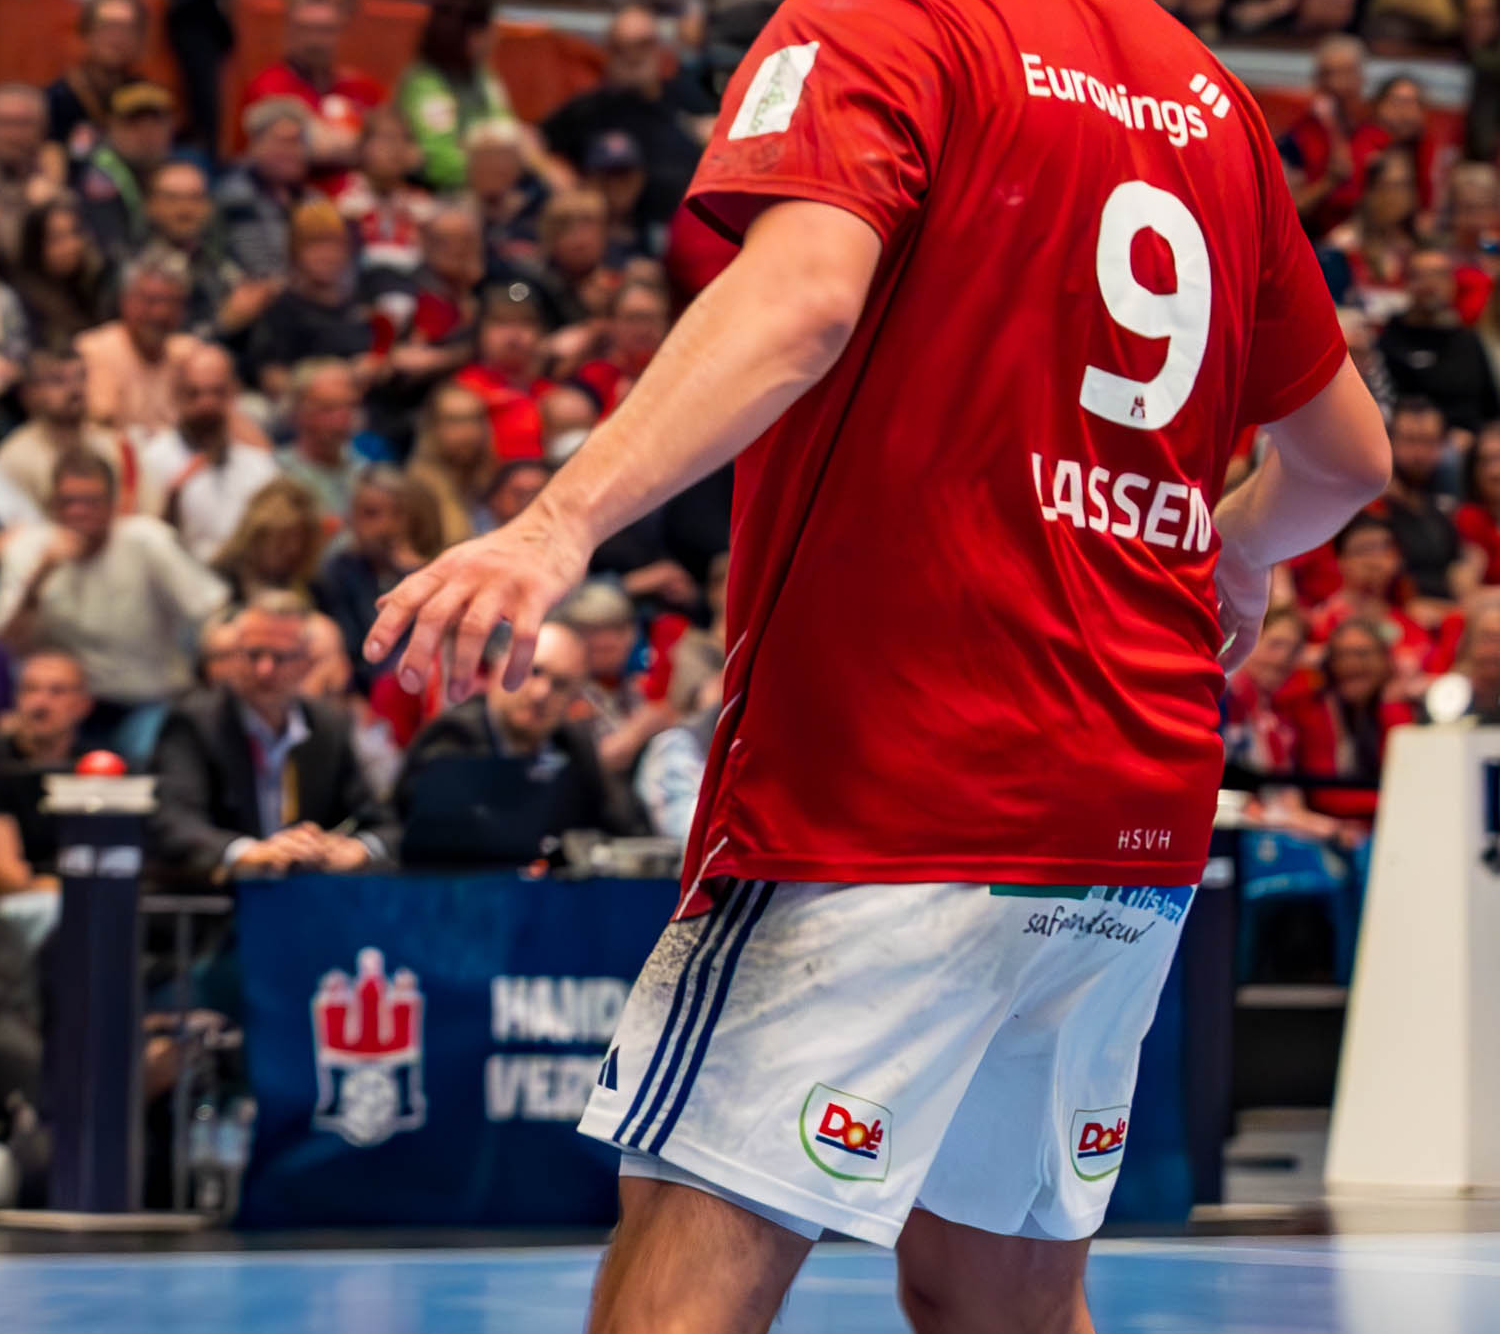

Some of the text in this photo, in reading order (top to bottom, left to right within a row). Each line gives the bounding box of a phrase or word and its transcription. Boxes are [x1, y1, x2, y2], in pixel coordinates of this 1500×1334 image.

[1021, 52, 1209, 147] Eurowings
[1079, 180, 1211, 430] 9
[1031, 452, 1212, 553] LASSEN
[1117, 829, 1171, 850] HSVH
